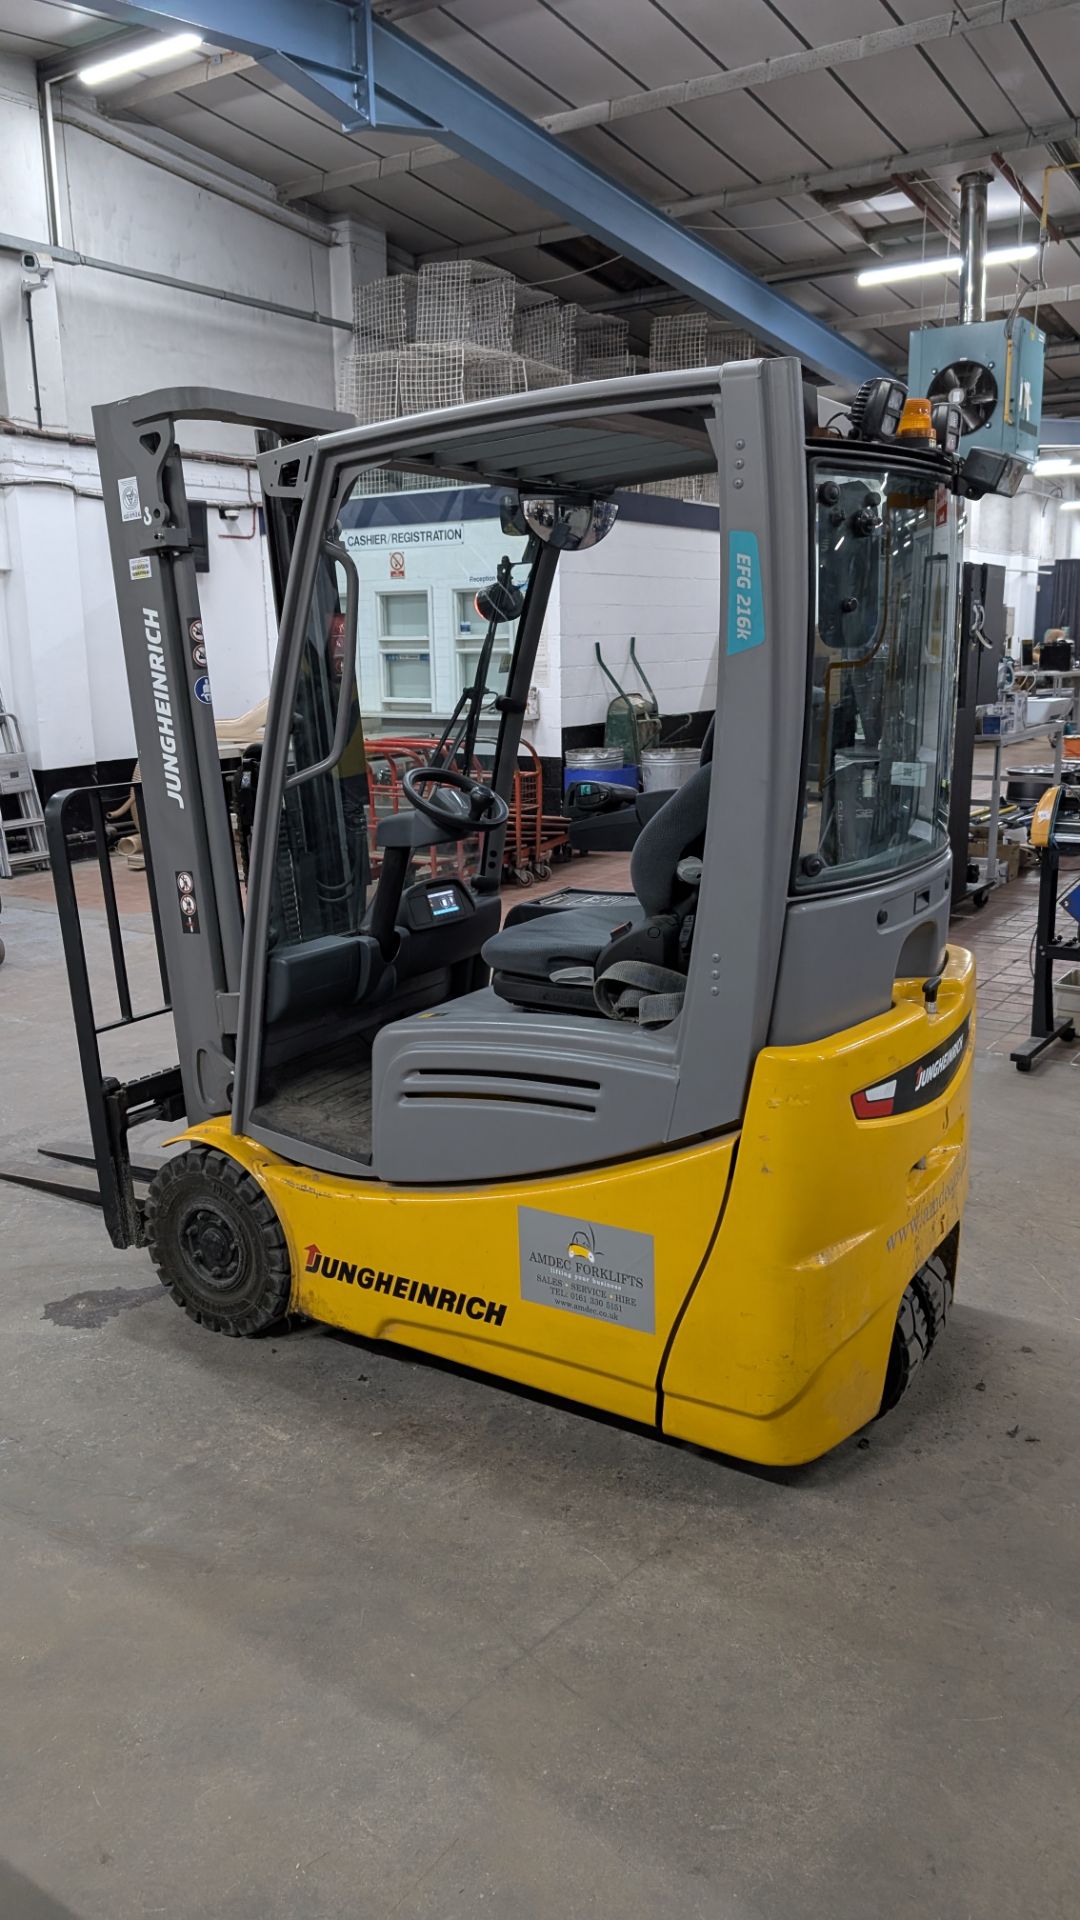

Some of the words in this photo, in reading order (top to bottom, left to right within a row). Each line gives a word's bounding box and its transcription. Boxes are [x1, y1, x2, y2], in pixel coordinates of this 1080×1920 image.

[347, 529, 462, 547] CASHIER/REGISTRATION
[469, 575, 496, 583] Reception
[737, 553, 751, 589] EFG
[737, 593, 752, 641] 216k
[143, 607, 185, 810] JUNGHEINRICH
[529, 1251, 572, 1271] AMDEC
[575, 1262, 644, 1289] FORKLIFTS
[574, 1274, 591, 1283] your
[592, 1276, 622, 1291] business
[305, 1254, 508, 1326] JUNGHEINRICH
[536, 1273, 563, 1287] SALES
[571, 1281, 607, 1299] SERVICE
[615, 1293, 637, 1307] HIRE
[570, 1294, 587, 1304] 0161
[555, 1298, 618, 1320] www.amdec.co.uk
